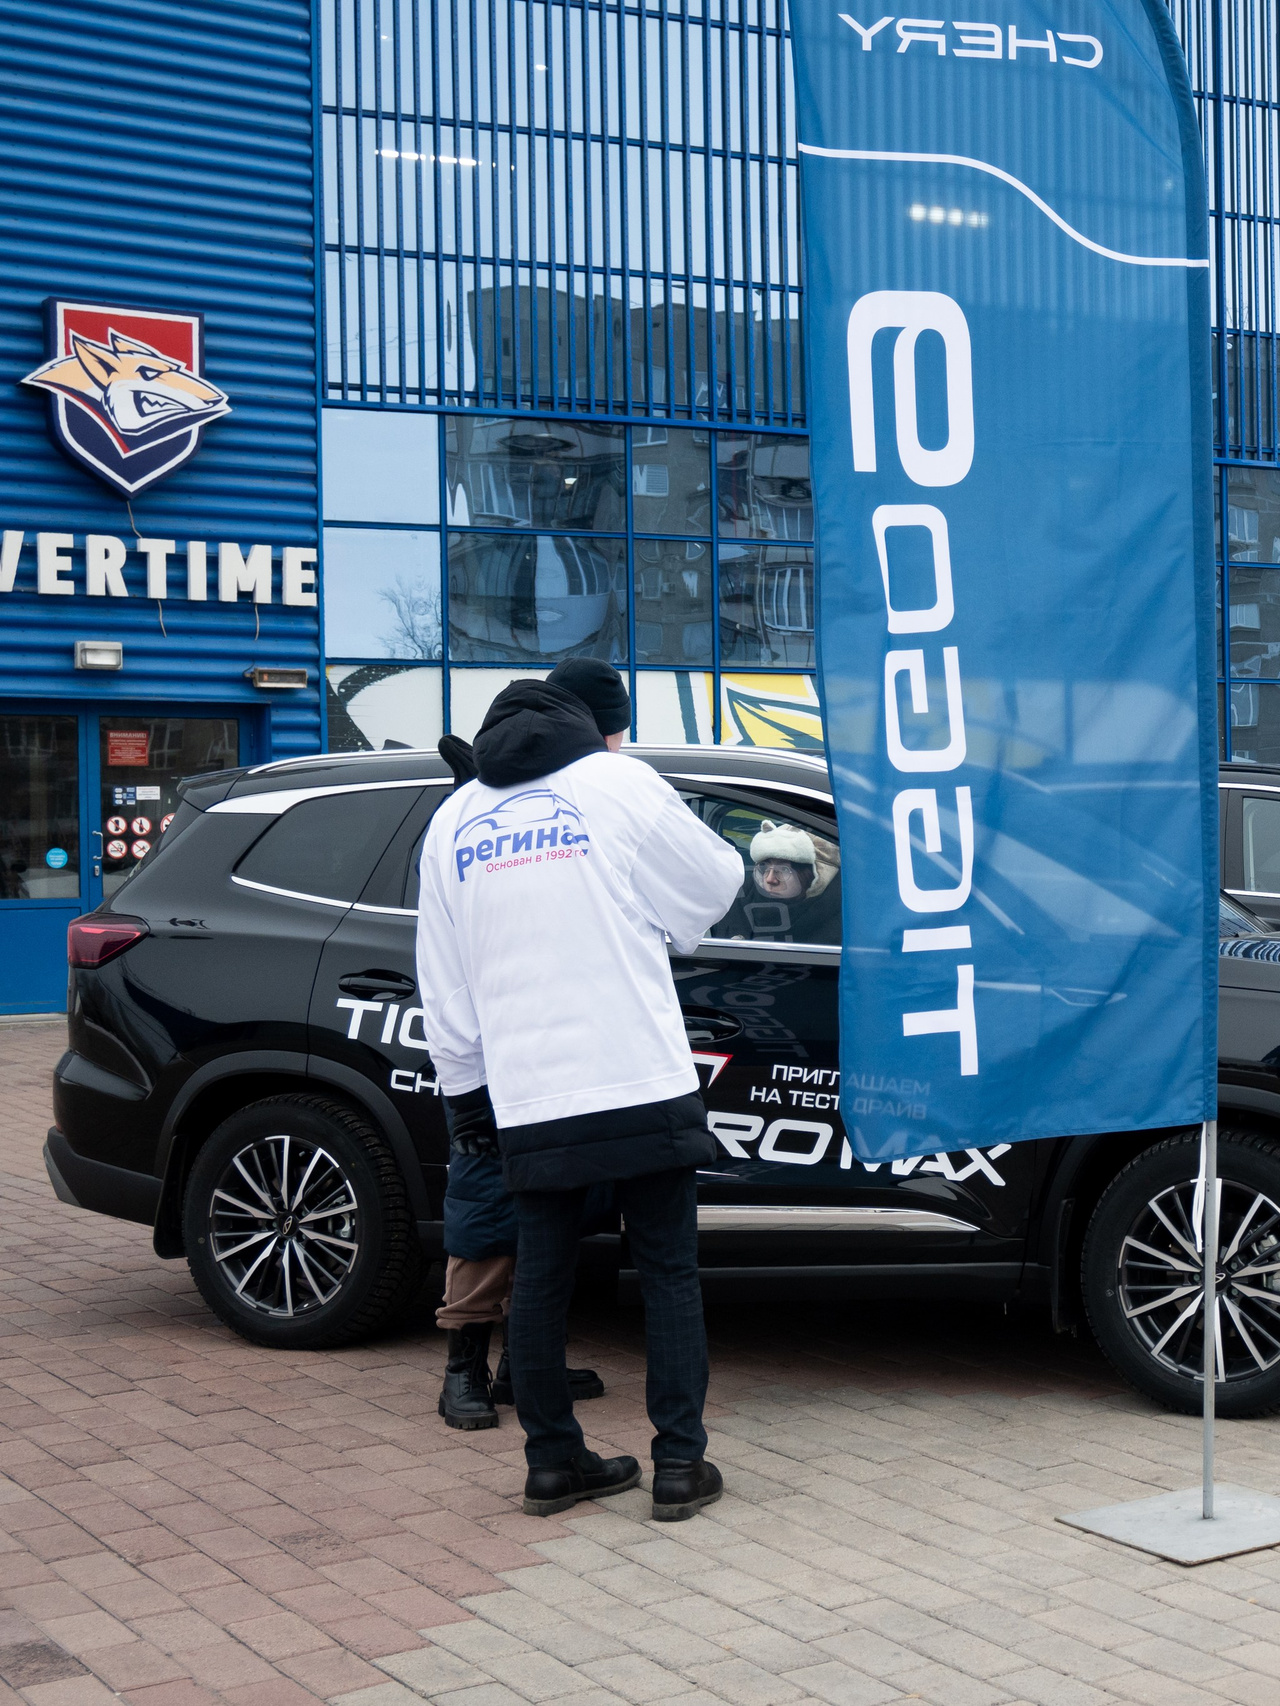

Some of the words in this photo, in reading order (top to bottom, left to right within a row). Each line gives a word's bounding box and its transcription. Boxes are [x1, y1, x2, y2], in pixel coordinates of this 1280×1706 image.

[485, 856, 532, 873] Основан
[535, 854, 542, 863] в
[546, 848, 573, 861] 1992
[750, 1086, 782, 1105] НА
